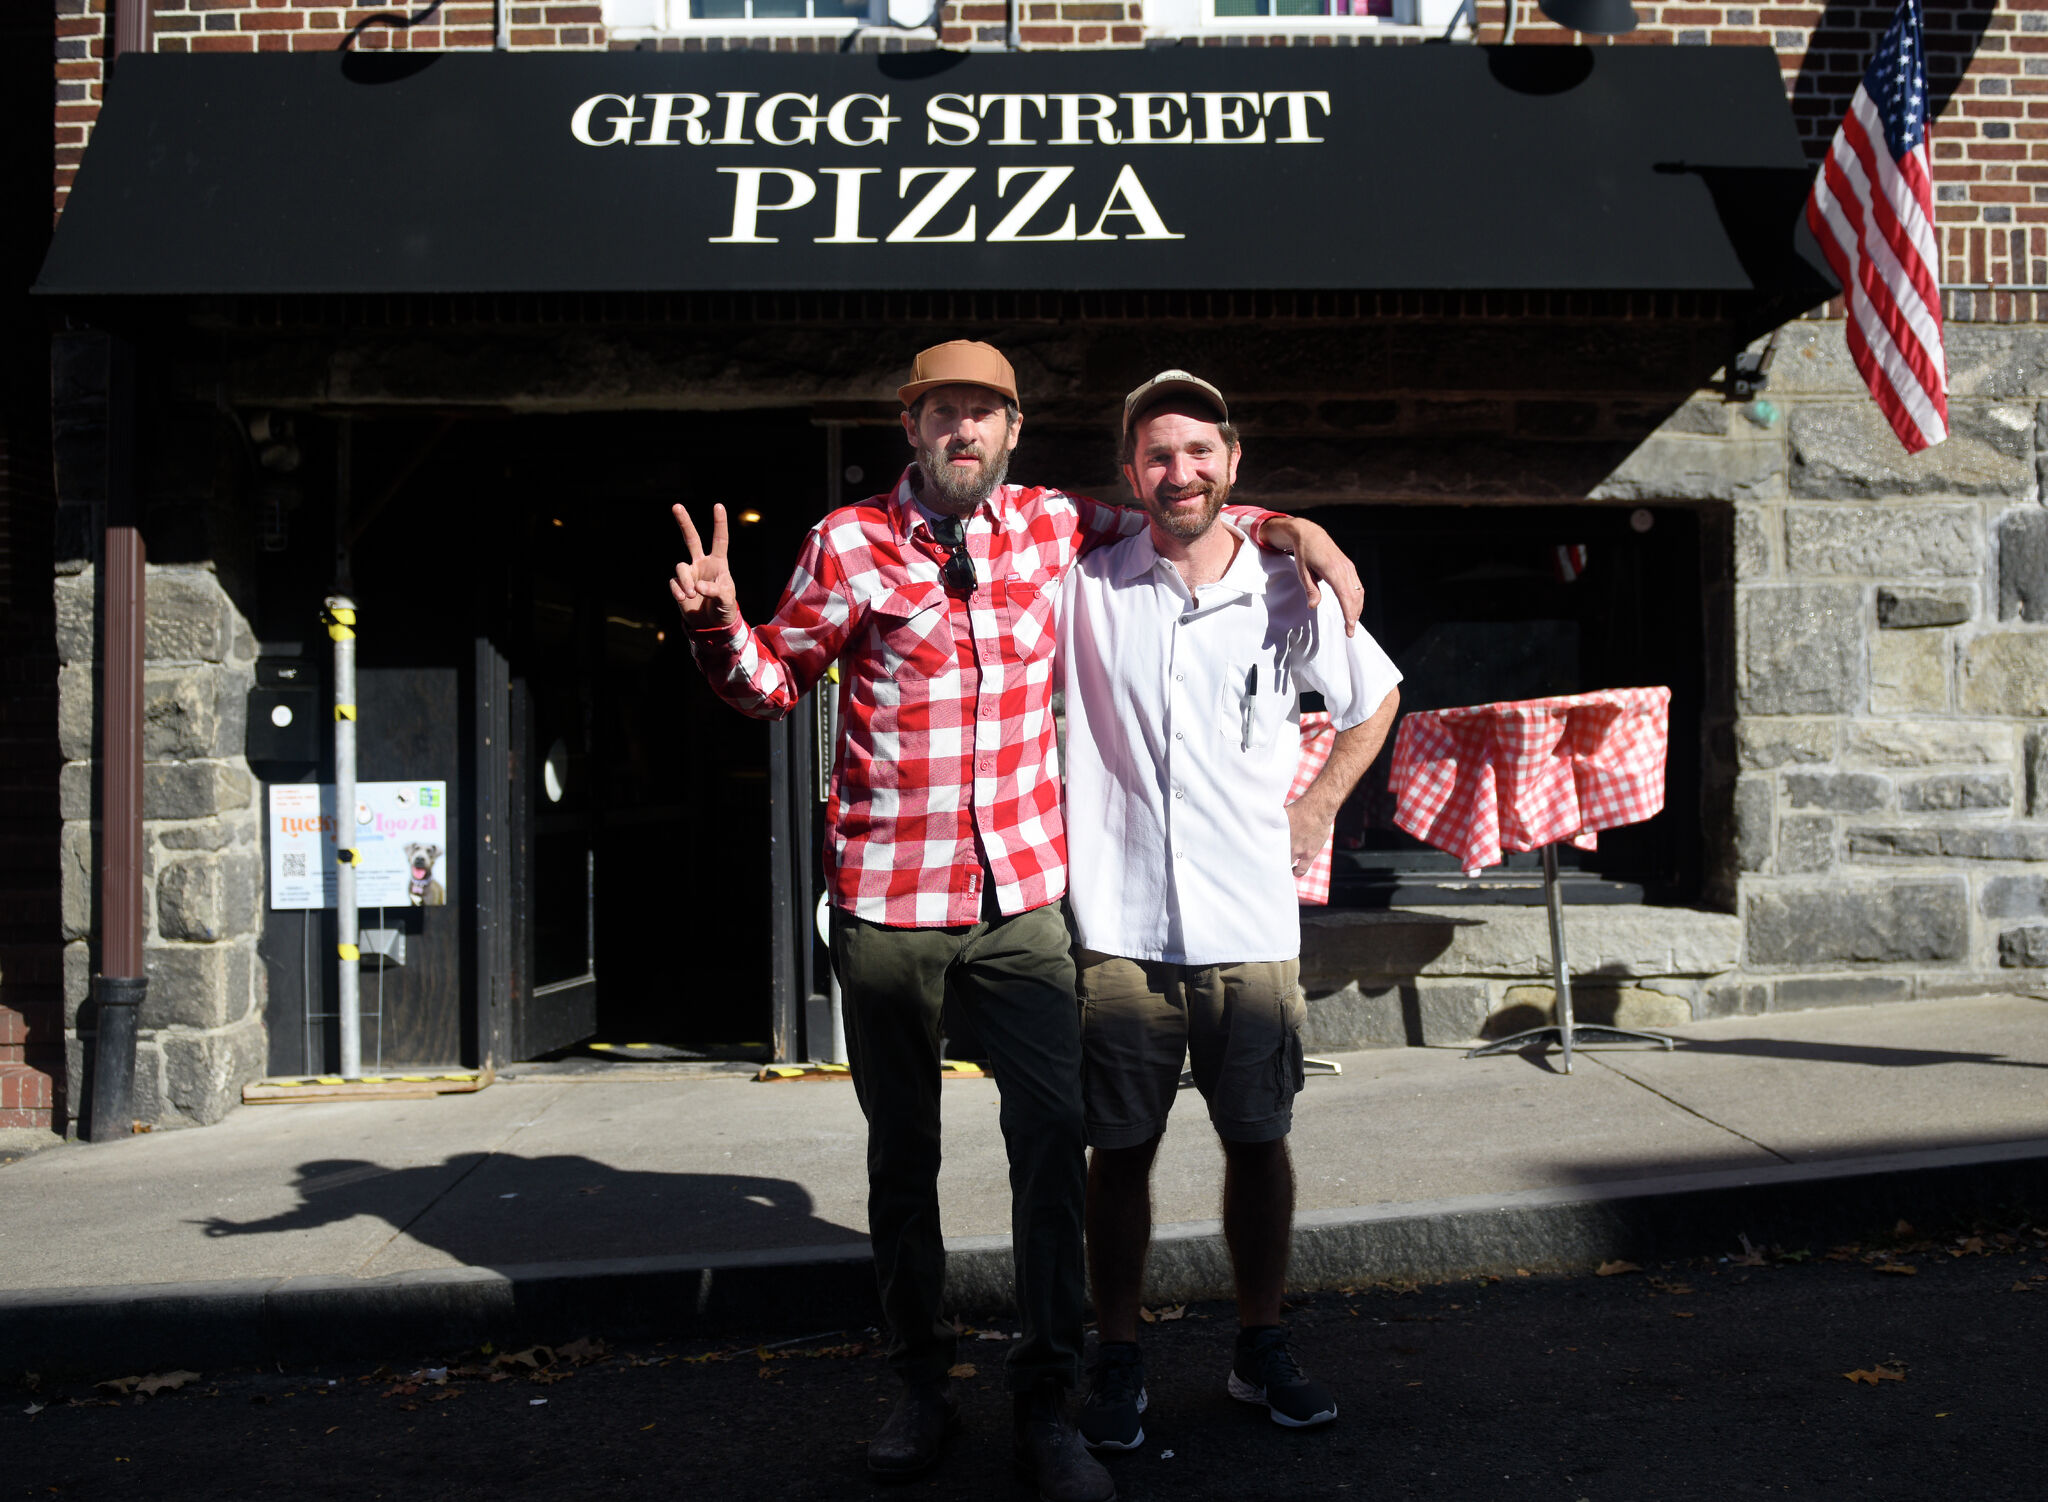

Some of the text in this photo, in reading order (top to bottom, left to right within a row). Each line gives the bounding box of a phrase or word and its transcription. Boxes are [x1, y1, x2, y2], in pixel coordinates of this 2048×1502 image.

[570, 91, 1331, 147] GRIGG STREET
[708, 164, 1186, 244] PIZZA
